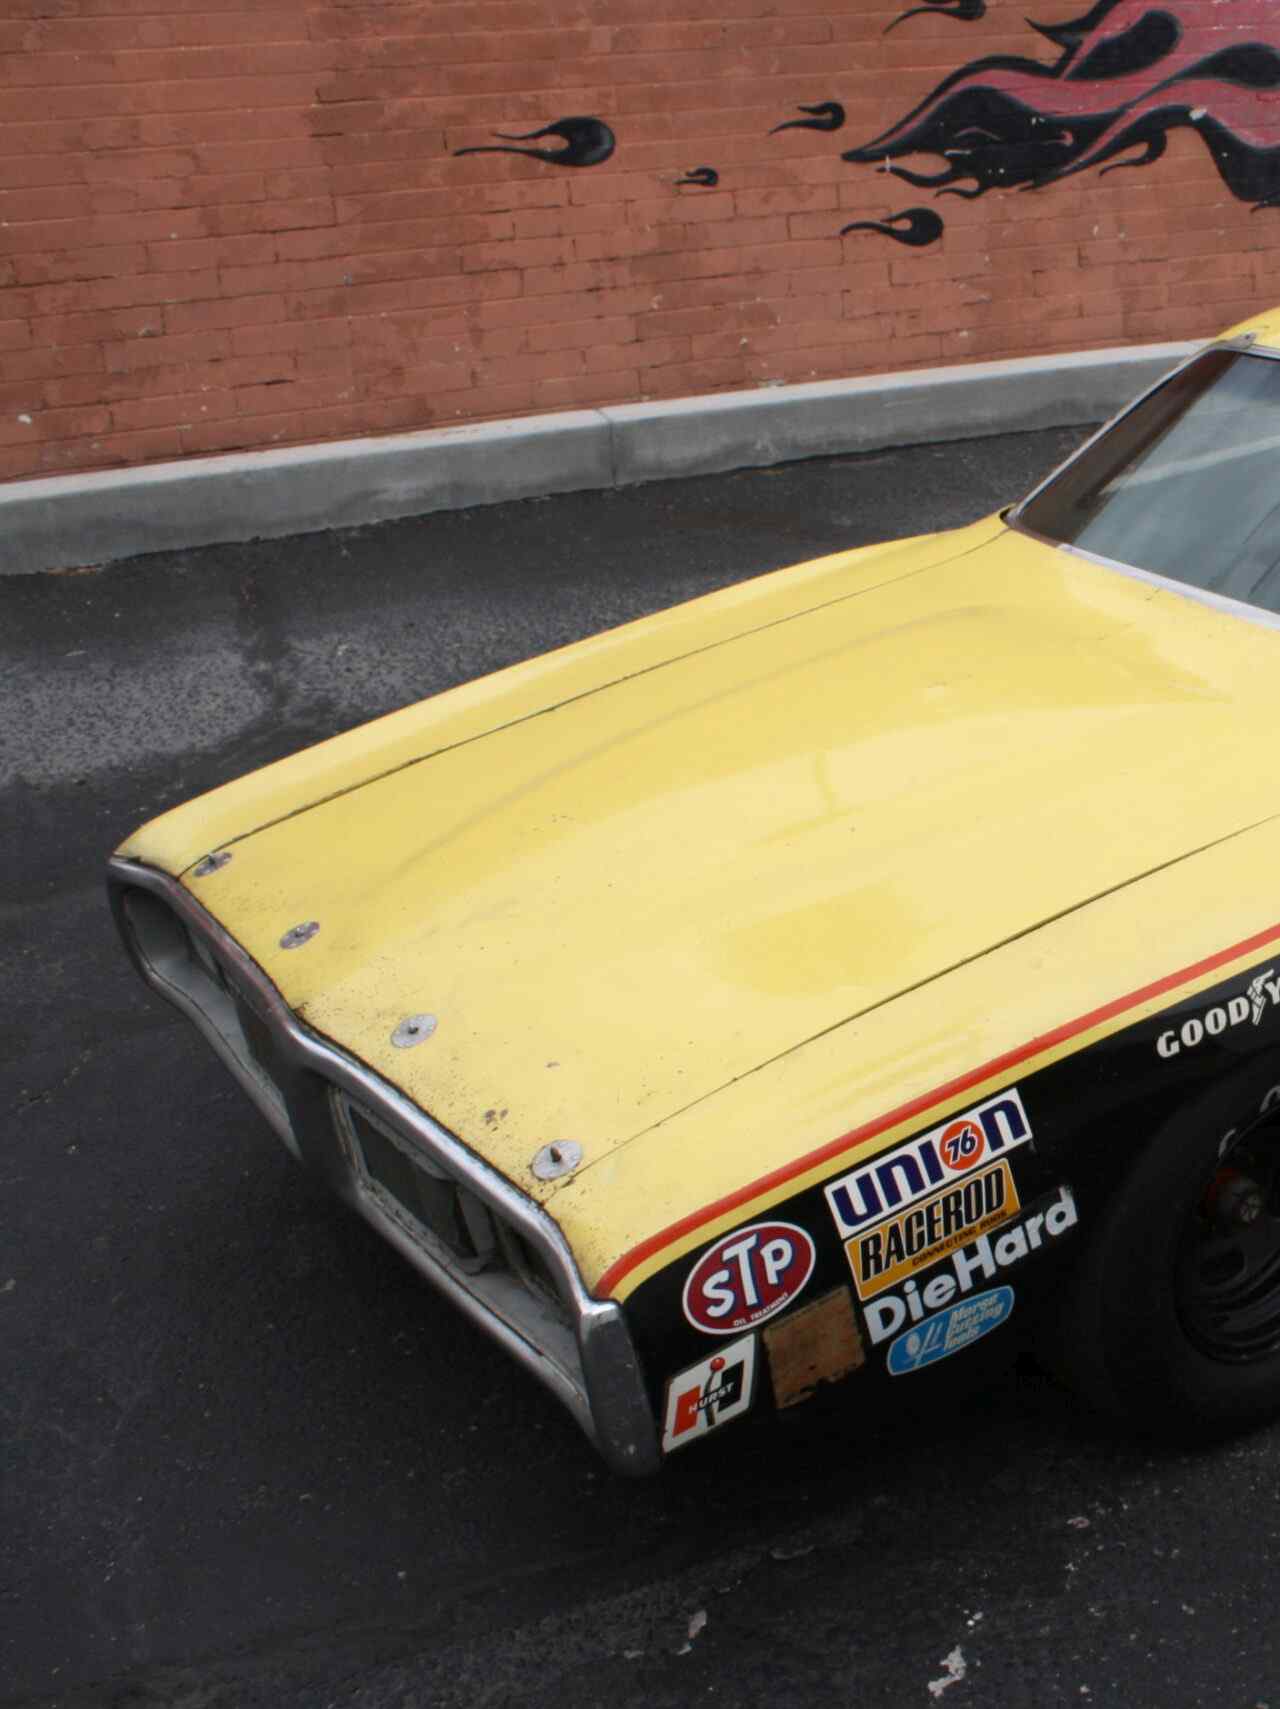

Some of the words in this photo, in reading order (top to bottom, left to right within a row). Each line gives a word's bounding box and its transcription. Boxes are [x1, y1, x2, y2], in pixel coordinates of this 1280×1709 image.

[944, 1126, 977, 1164] 76
[859, 1164, 1007, 1283] RACEROD
[862, 1183, 1079, 1346] DieHard
[702, 1233, 794, 1319] STP
